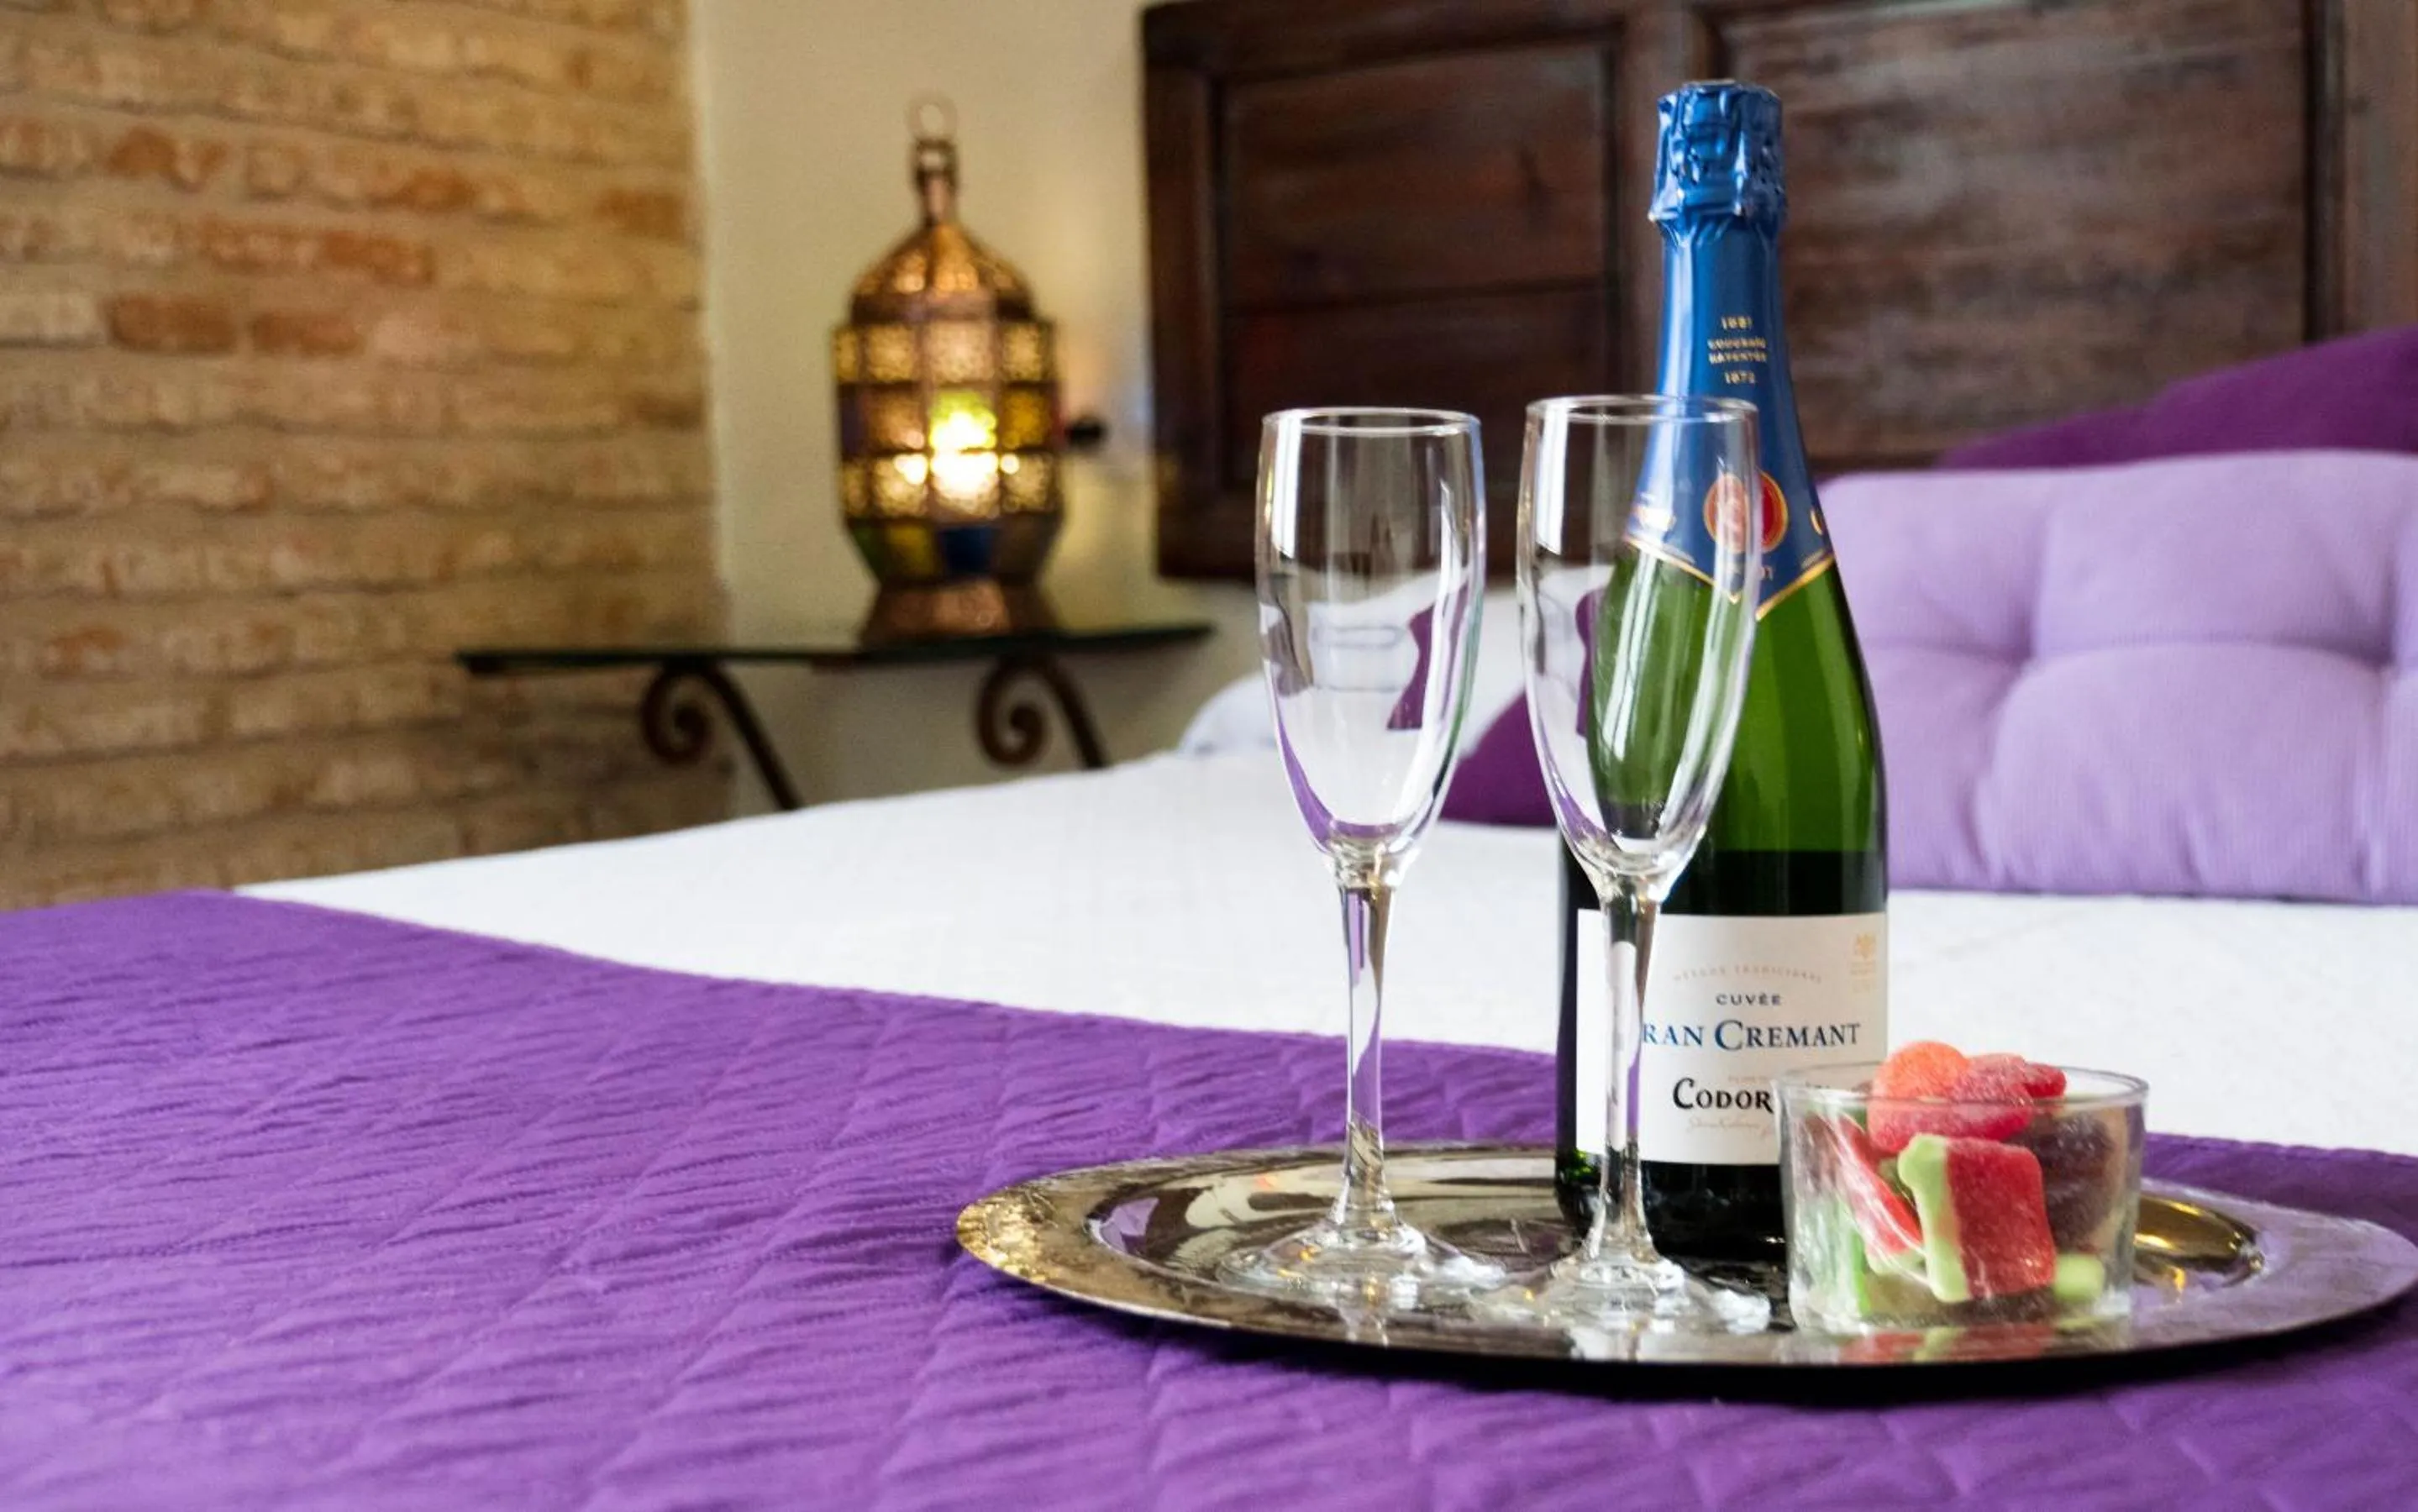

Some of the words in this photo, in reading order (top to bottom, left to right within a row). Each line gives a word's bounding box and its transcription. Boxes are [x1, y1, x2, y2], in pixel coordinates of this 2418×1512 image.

[1715, 992, 1781, 1006] CUVÉE
[1642, 1022, 1705, 1047] RAN
[1714, 1019, 1861, 1051] CREMANT
[1673, 1077, 1774, 1115] CODOR
